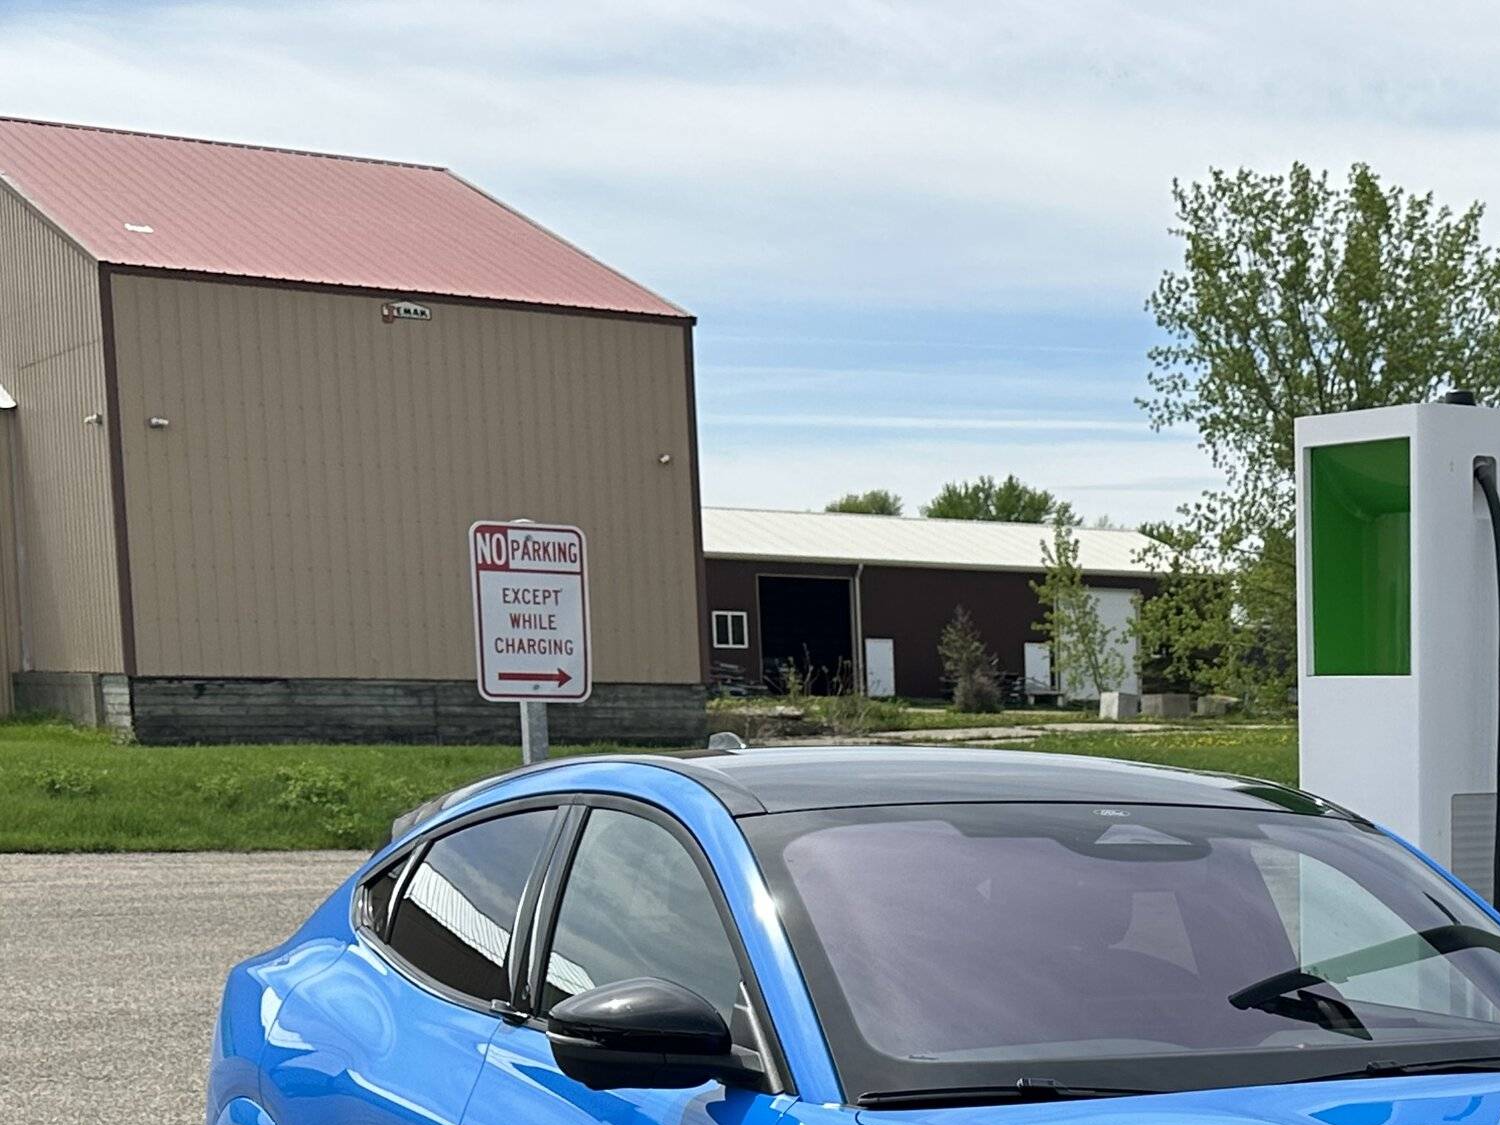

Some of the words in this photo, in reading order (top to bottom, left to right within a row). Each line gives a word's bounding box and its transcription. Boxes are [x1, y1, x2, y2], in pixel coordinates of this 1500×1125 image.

[476, 532, 507, 566] NO
[511, 540, 578, 564] PARKING
[502, 587, 562, 606] EXCEPT
[509, 613, 557, 631] WHILE
[494, 636, 574, 656] CHARGING
